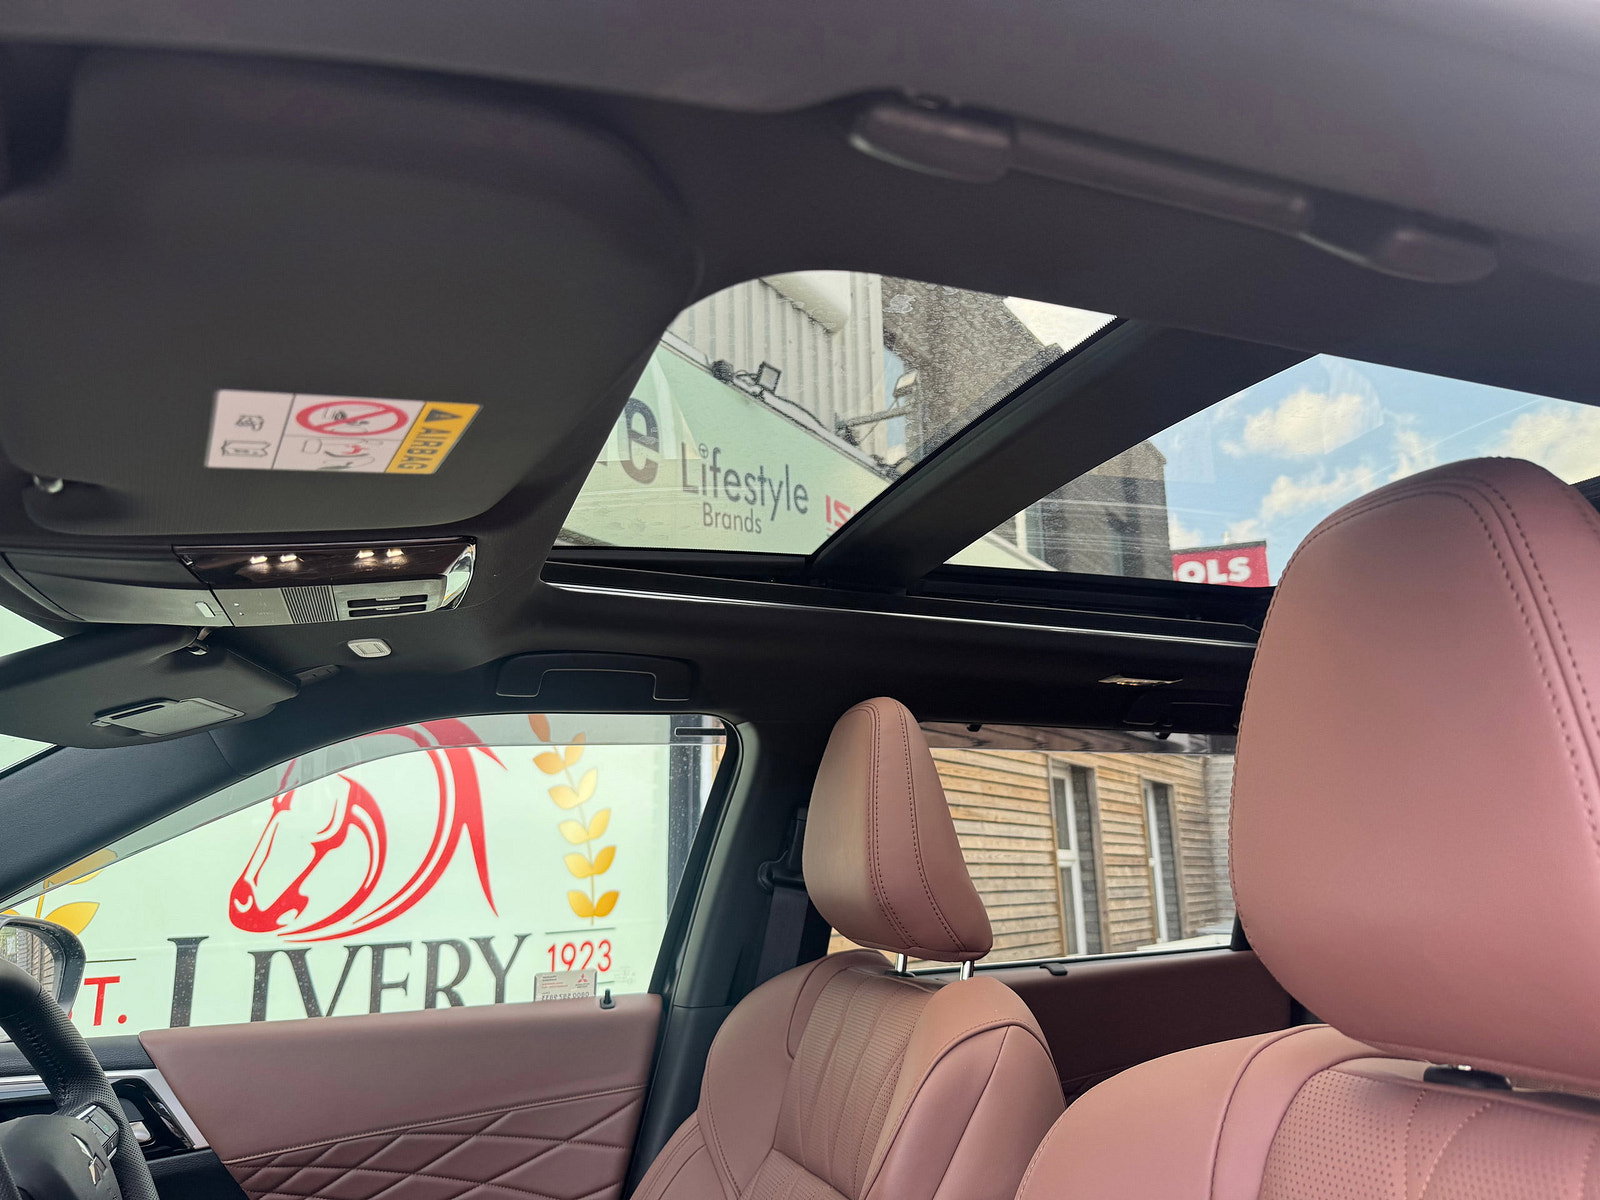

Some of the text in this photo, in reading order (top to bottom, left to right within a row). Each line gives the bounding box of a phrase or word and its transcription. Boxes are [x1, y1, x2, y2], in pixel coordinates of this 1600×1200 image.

[399, 428, 452, 470] AIRBAG
[597, 397, 660, 484] e
[681, 441, 809, 521] Lifestyle
[702, 502, 762, 534] Brands
[825, 495, 857, 528] IS
[1173, 556, 1252, 584] OLS
[547, 939, 612, 972] 1923
